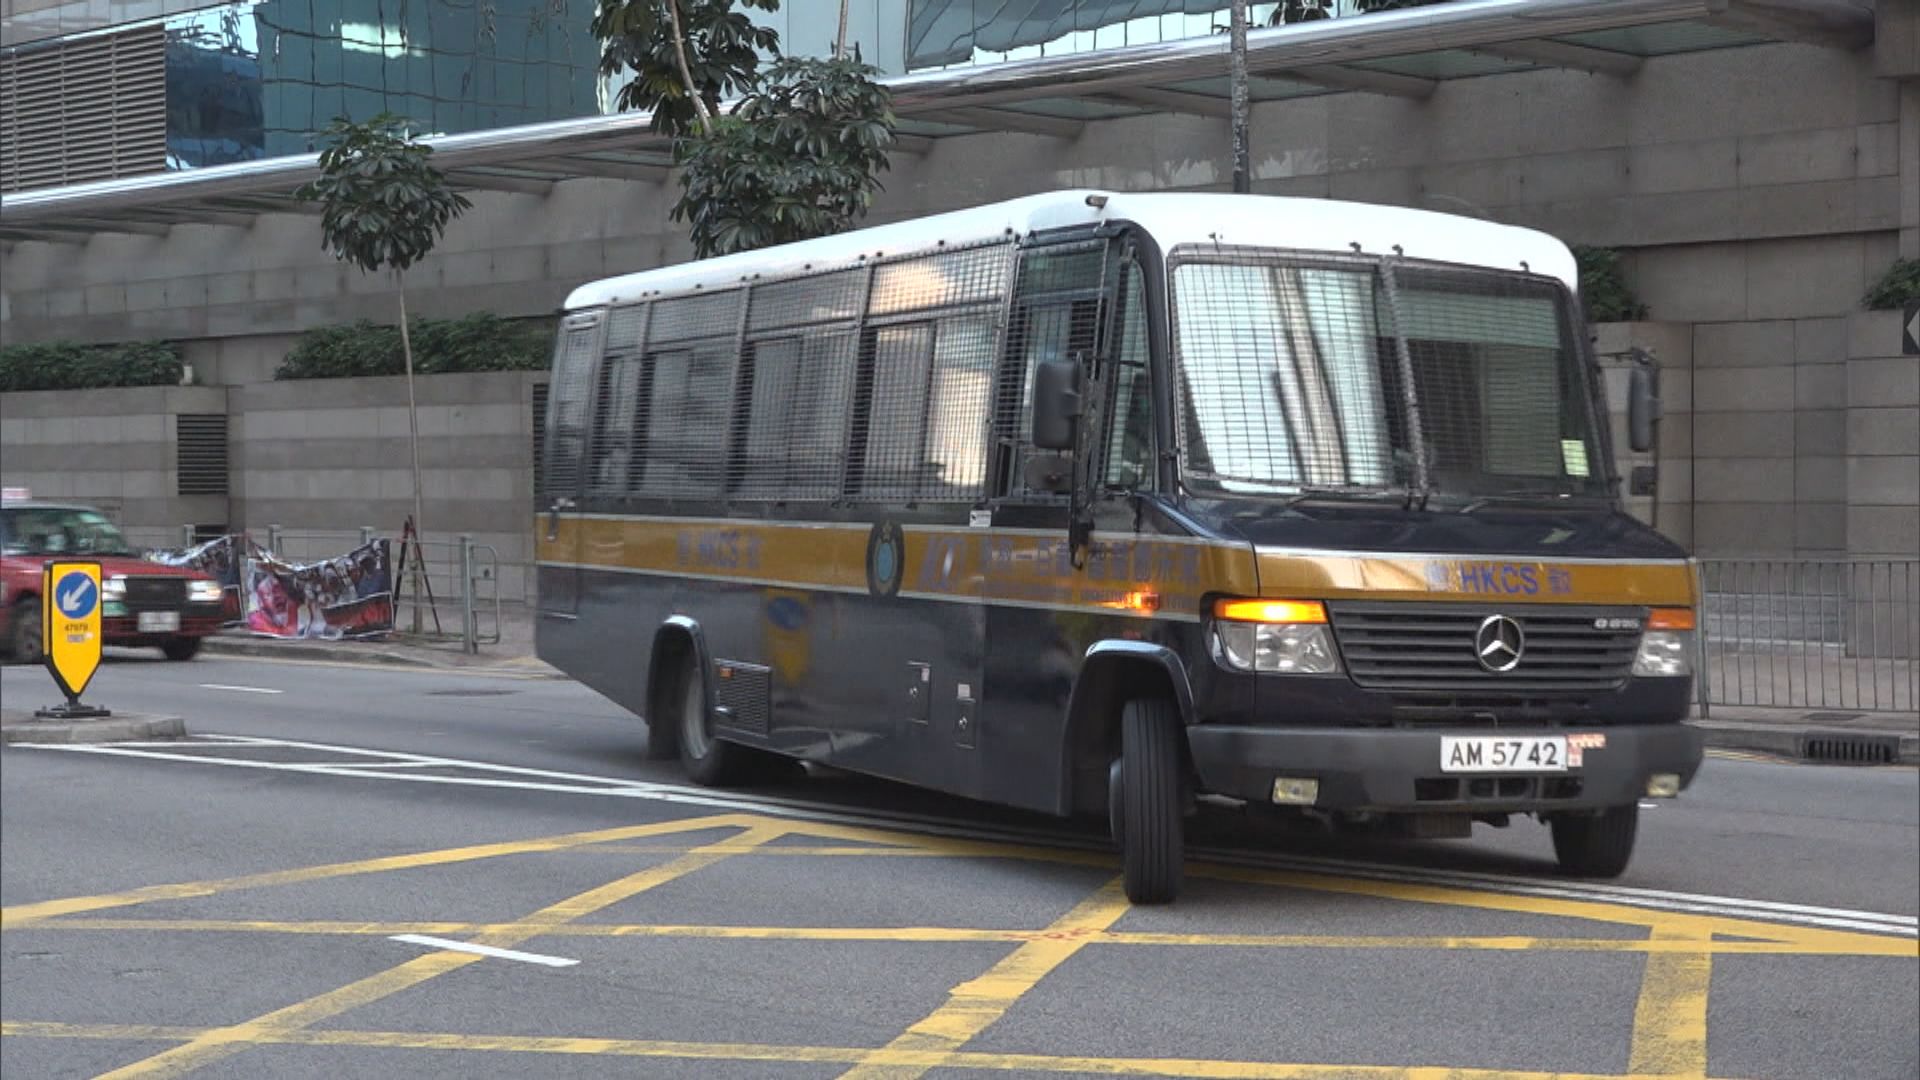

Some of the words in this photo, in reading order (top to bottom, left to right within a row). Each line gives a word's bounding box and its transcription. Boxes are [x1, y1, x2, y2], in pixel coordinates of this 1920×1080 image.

[1461, 563, 1539, 594] HKCS
[1450, 742, 1482, 766] AM
[1492, 742, 1557, 766] 5742
